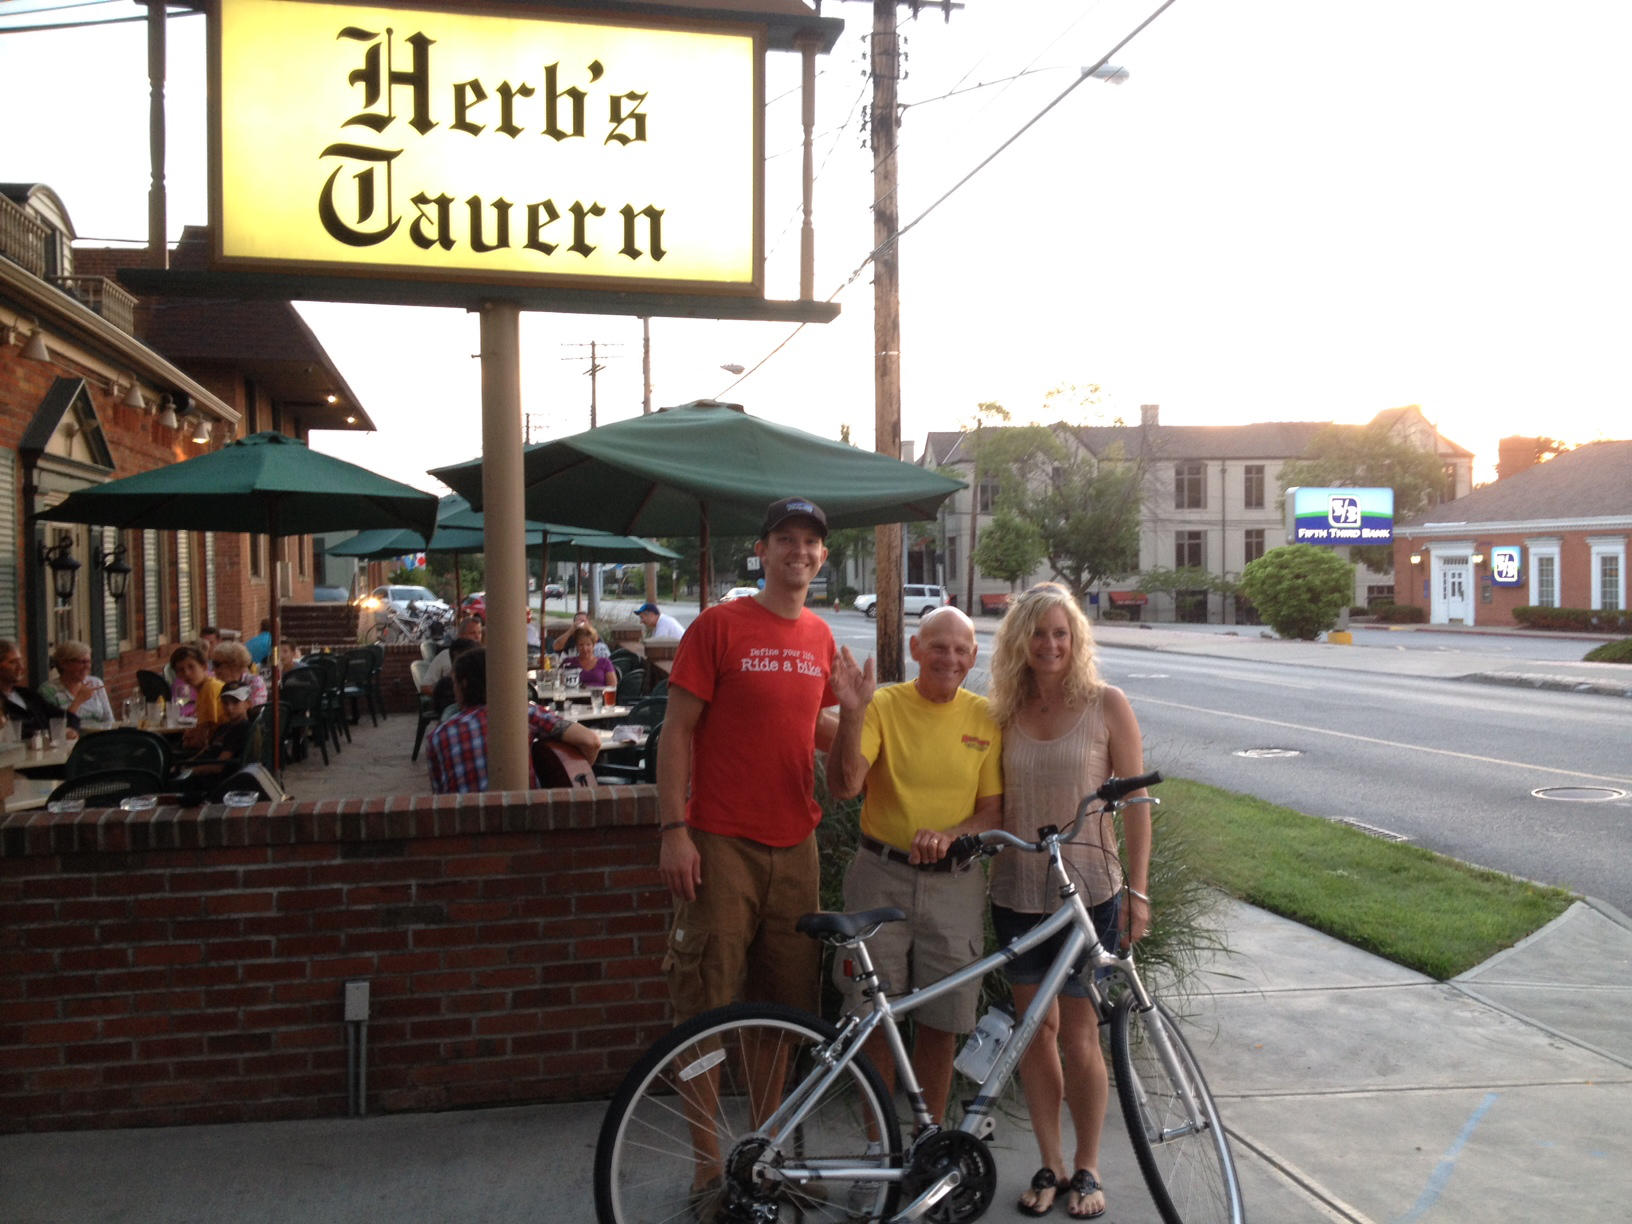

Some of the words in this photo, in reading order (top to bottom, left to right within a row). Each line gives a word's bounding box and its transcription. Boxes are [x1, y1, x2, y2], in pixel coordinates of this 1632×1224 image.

[336, 27, 649, 146] Herb's
[318, 143, 667, 262] Tavern
[741, 658, 779, 672] Ride
[783, 661, 793, 672] a
[750, 648, 779, 657] Define
[783, 649, 801, 657] your
